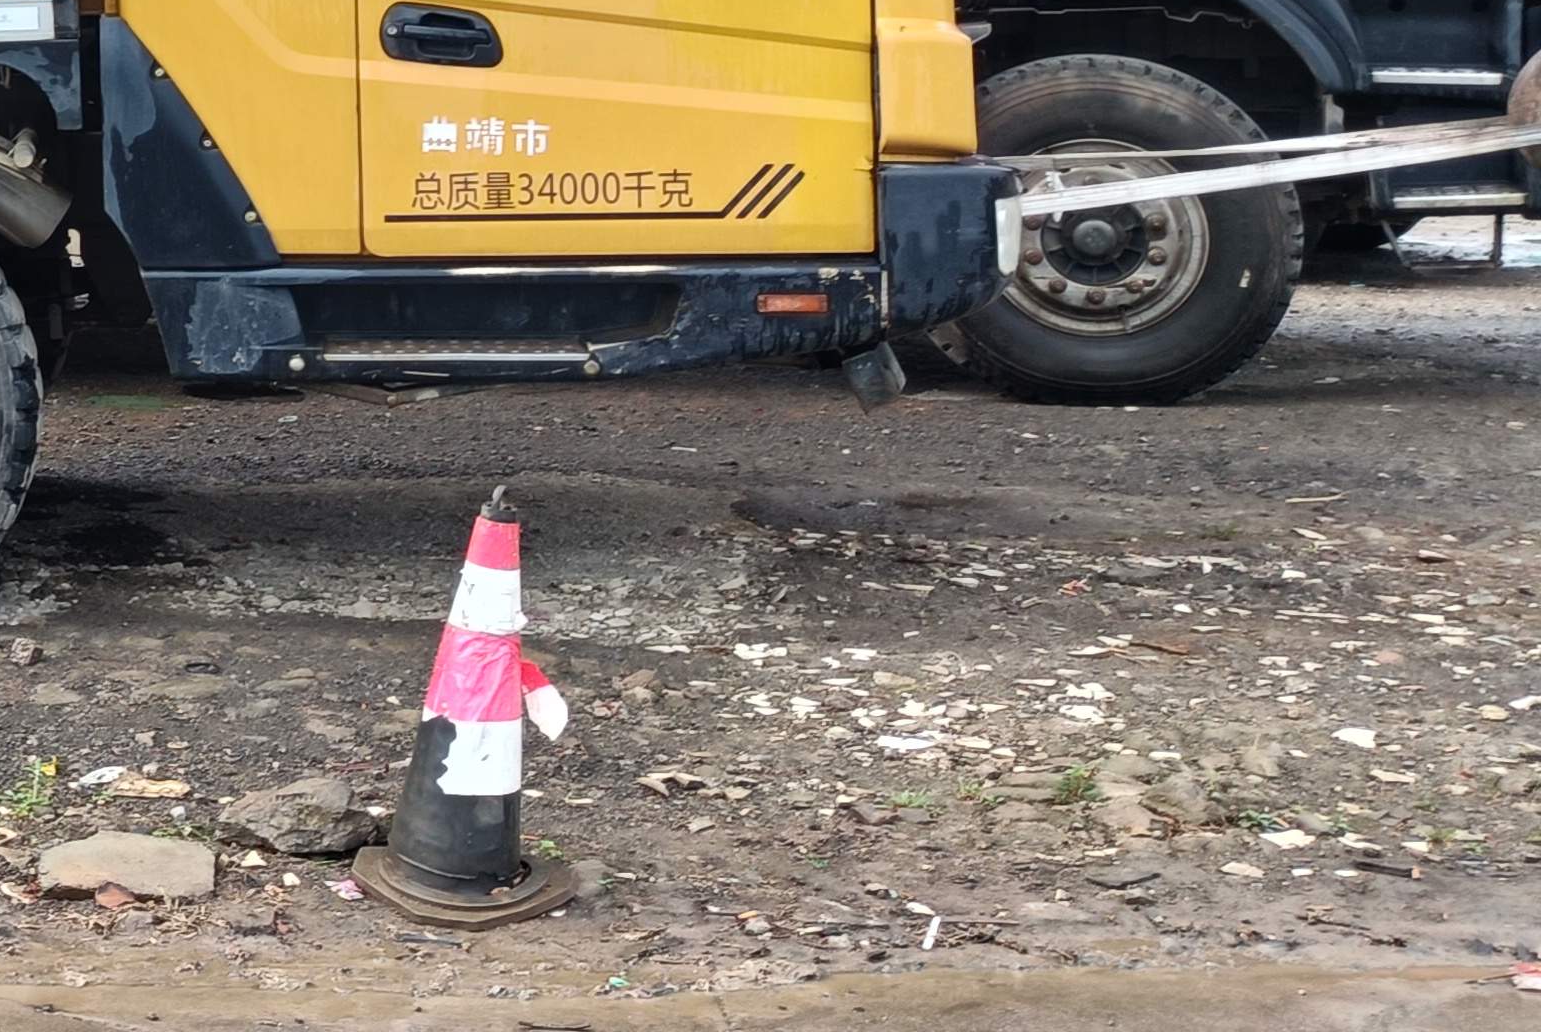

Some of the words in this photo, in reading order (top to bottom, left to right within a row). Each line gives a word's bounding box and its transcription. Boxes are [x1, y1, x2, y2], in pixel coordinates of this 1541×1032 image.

[421, 116, 550, 157] 曲靖市
[411, 168, 694, 211] 总质量34000千克
